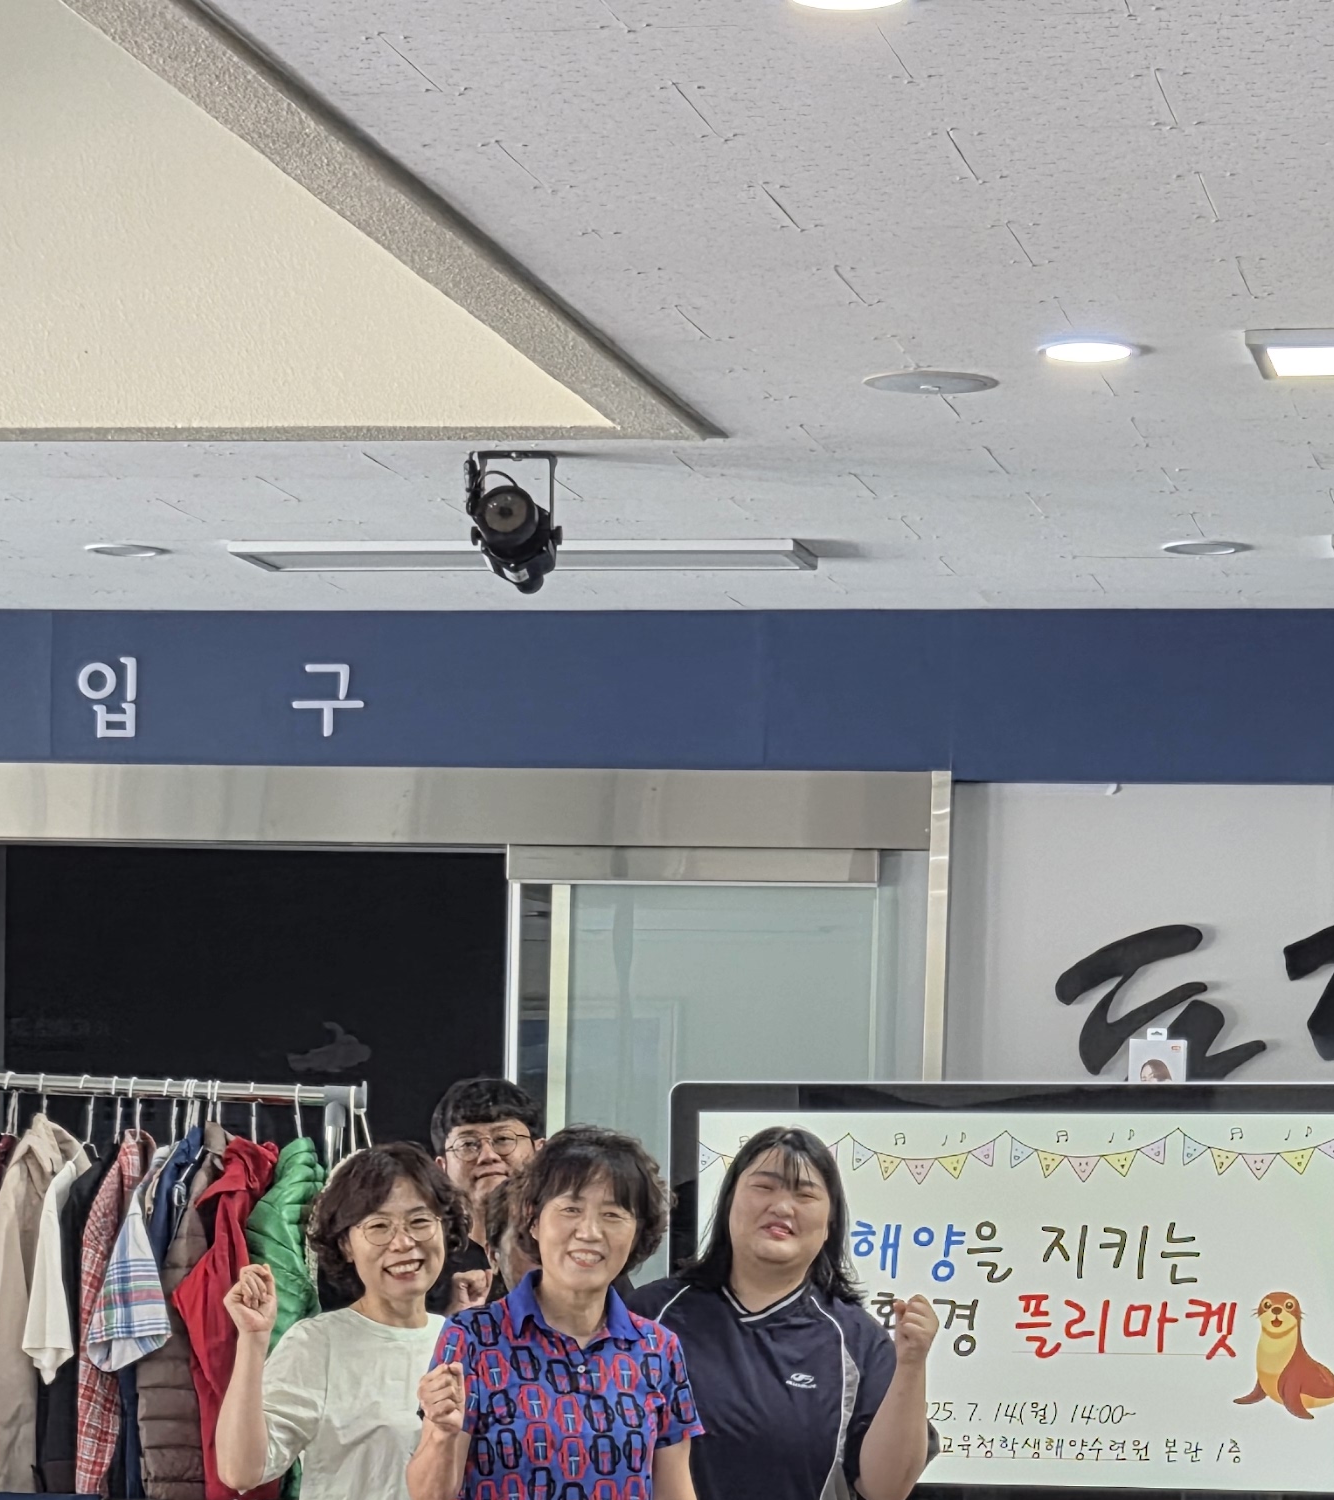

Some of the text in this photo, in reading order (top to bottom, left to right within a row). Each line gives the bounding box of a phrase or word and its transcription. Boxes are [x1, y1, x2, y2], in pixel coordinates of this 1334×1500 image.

[78, 656, 365, 738] 입 구
[850, 1220, 1201, 1285] 해양을 지키는
[1015, 1293, 1238, 1360] 플리마켓
[1164, 1439, 1202, 1464] 본관
